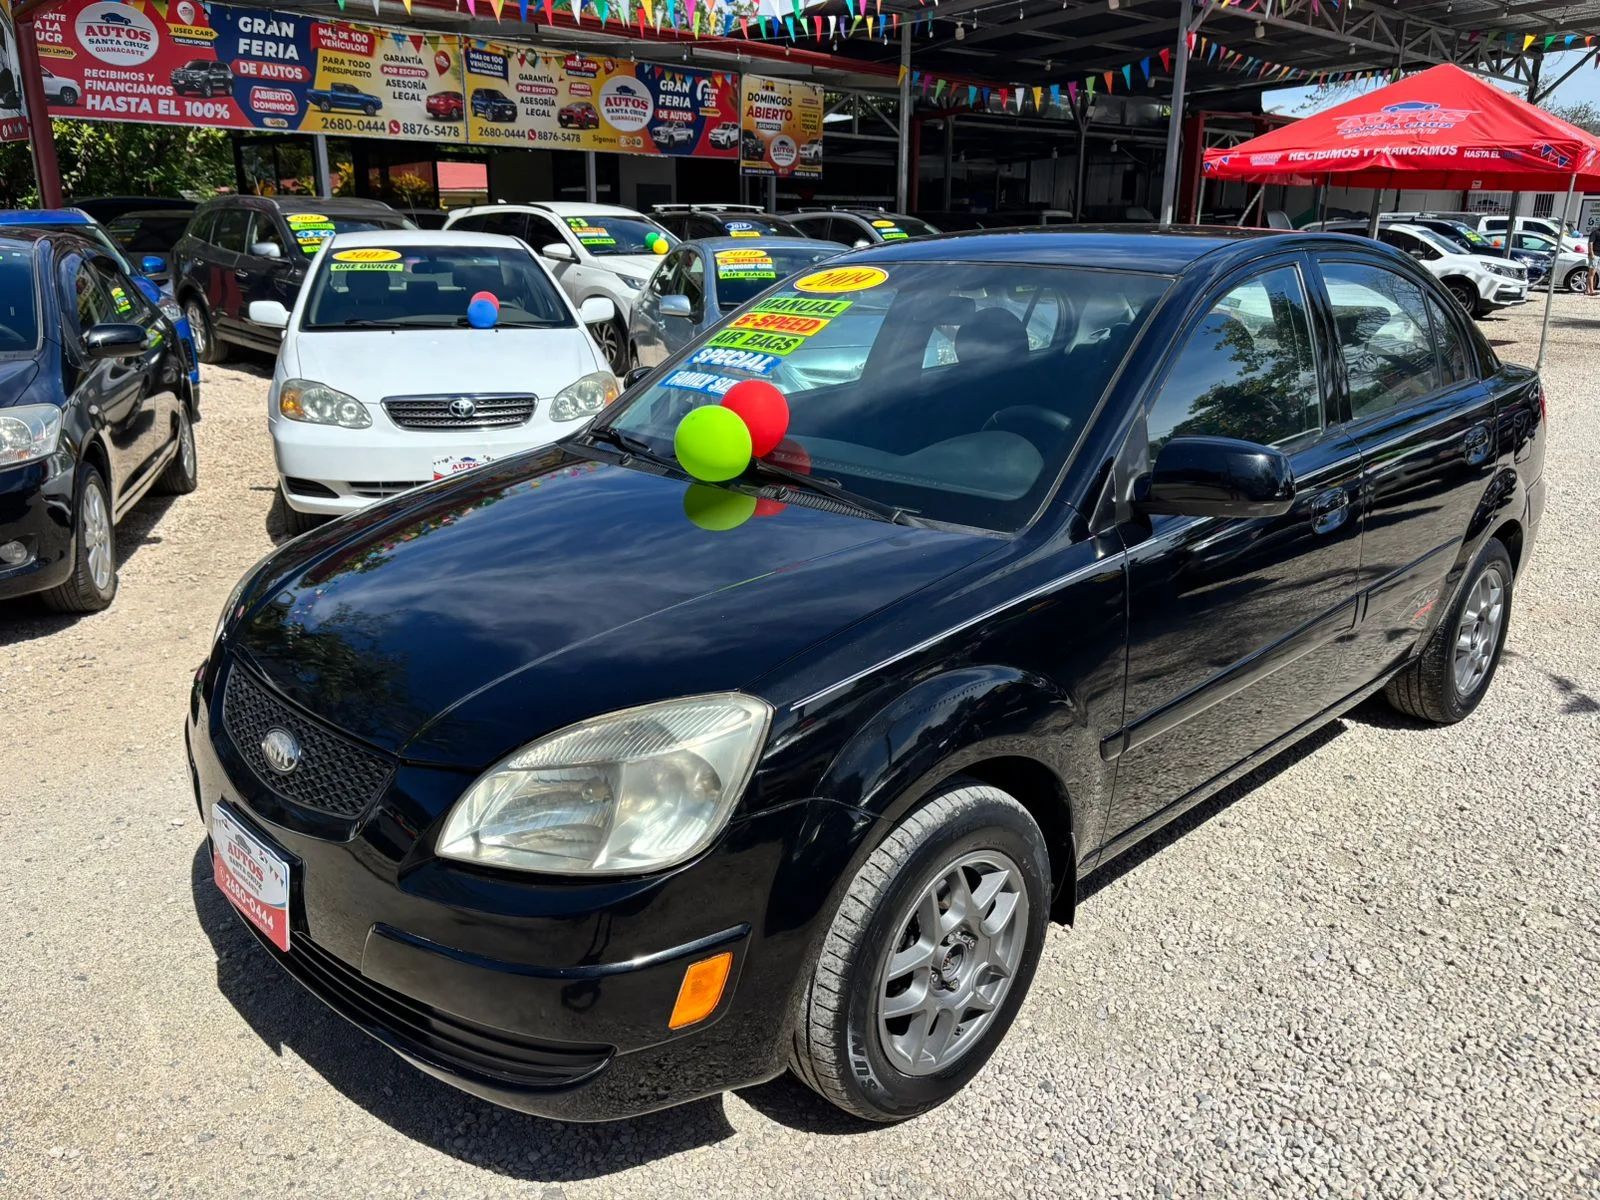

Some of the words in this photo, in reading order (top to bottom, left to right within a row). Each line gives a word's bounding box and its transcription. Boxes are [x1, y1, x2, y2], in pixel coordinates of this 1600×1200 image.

[34, 20, 43, 30] A
[45, 21, 61, 32] LA
[238, 16, 295, 38] GRAN
[36, 31, 63, 44] UCR
[85, 25, 152, 42] AUTOS
[338, 32, 349, 40] DE
[350, 32, 369, 44] 100
[88, 38, 122, 46] SANTA
[123, 40, 150, 50] CRUZ
[238, 38, 300, 60] FERIA
[320, 38, 368, 54] VEHÍCULOS!
[322, 56, 346, 66] PARA
[348, 60, 371, 69] TODO
[383, 54, 424, 65] GARANTÍA
[491, 56, 504, 64] 100
[84, 68, 145, 81] RECIBIMOS
[147, 73, 155, 82] Y
[239, 61, 258, 75] DE
[261, 64, 303, 80] AUTOS
[322, 66, 372, 78] PRESUPUESTO
[383, 66, 398, 74] POR
[399, 67, 426, 77] ESCRITO
[386, 78, 427, 90] ASESORÍA
[518, 72, 554, 84] GARANTÍA
[84, 80, 174, 96] FINANCIAMOS
[532, 86, 556, 94] ESCRITO
[660, 80, 690, 94] GRAN
[254, 90, 292, 102] ABIERTO
[392, 91, 422, 102] LEGAL
[520, 96, 556, 107] ASESORÍA
[605, 96, 648, 110] AUTOS
[658, 94, 691, 108] FERIA
[748, 92, 792, 106] DOMINGOS
[86, 94, 153, 114] HASTA
[158, 99, 180, 116] EL
[184, 101, 230, 120] 100%
[253, 100, 296, 112] DOMINGOS
[704, 100, 716, 108] UCR
[526, 108, 552, 117] LEGAL
[658, 110, 668, 120] DE
[670, 112, 692, 121] AUTOS
[746, 106, 793, 122] ABIERTO
[320, 117, 386, 132] 2680-0444
[402, 122, 460, 137] 8876-5478
[478, 126, 526, 138] 2680-0444
[538, 130, 580, 143] 8876-5478
[772, 146, 794, 154] AUTOS
[1288, 148, 1360, 161] RECIBIMOS
[1363, 148, 1370, 157] Y
[1464, 150, 1490, 158] HASTA
[1490, 150, 1500, 158] EL
[802, 272, 876, 287] 2009
[757, 298, 840, 316] MANUAL
[734, 313, 821, 332] 5-SPEED
[708, 331, 746, 344] AIR
[740, 334, 800, 351] BAGS
[692, 348, 774, 371] SPECIAL
[665, 370, 719, 390] FAMILY
[227, 842, 264, 882] AUTOS
[228, 856, 246, 875] SANTA
[246, 870, 263, 891] CRUZ
[225, 874, 274, 931] 2680-0444
